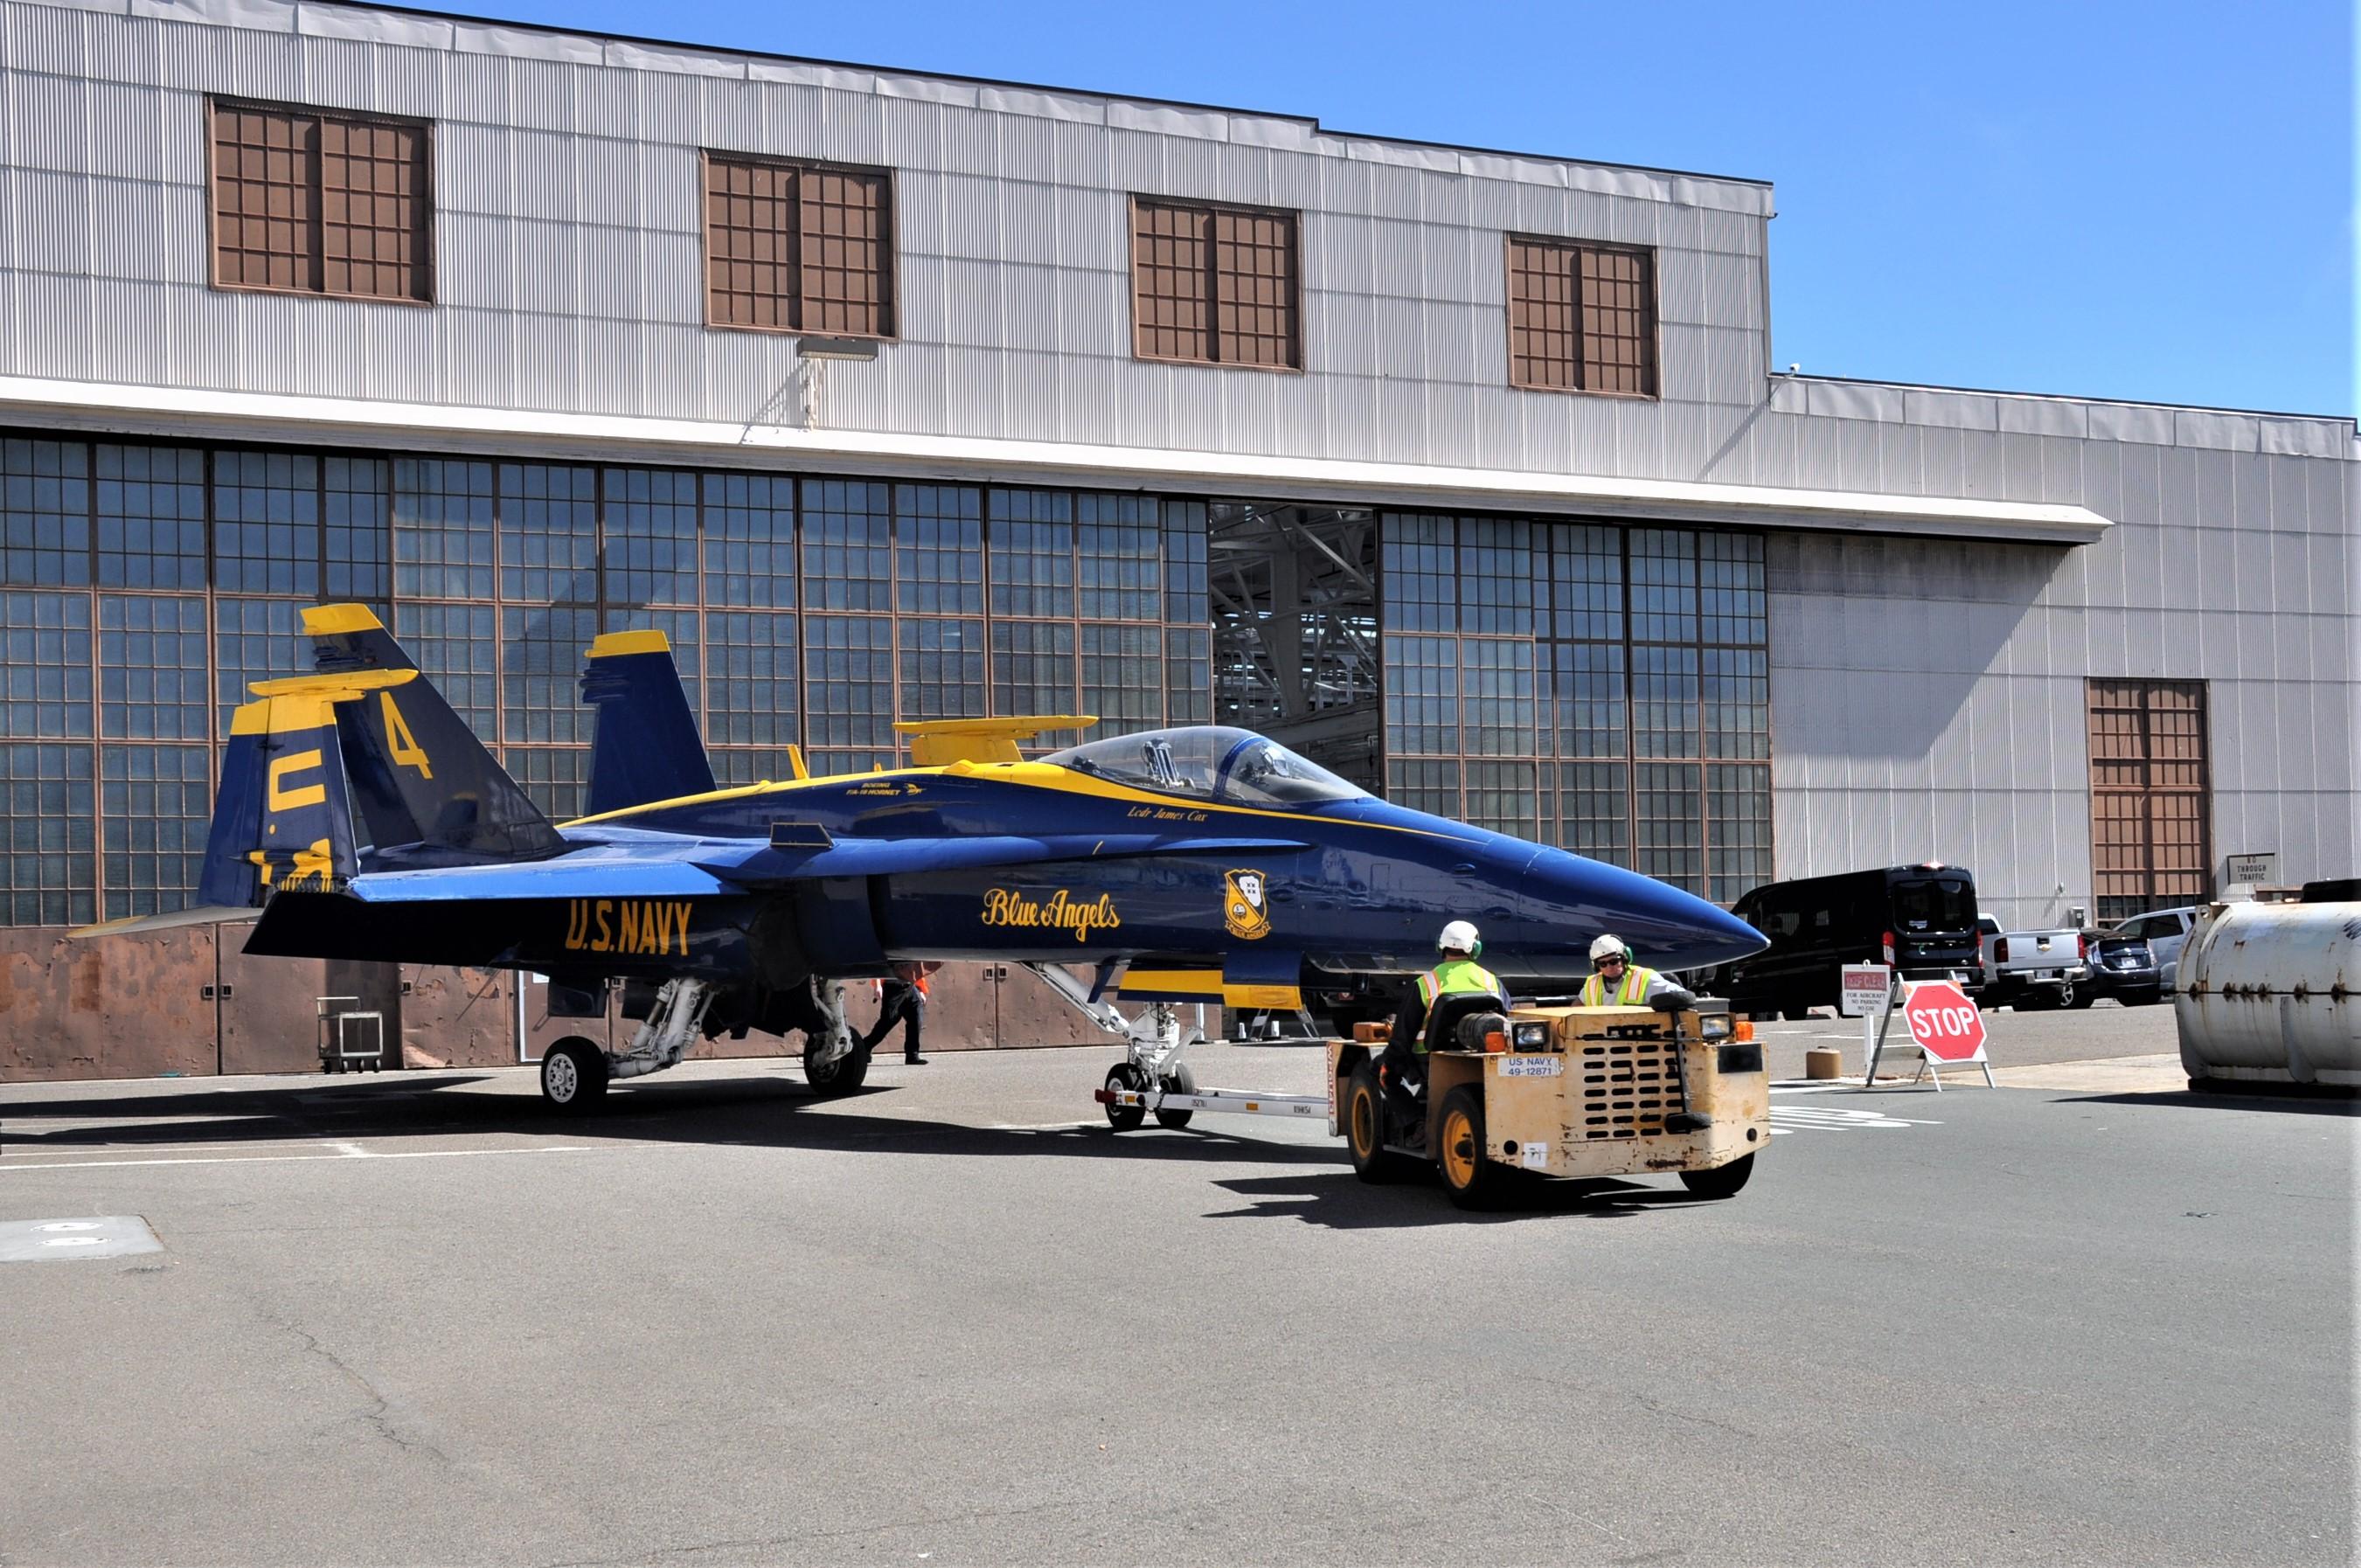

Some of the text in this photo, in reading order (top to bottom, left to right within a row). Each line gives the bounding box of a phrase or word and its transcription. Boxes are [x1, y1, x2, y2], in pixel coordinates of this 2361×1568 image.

[379, 690, 434, 780] 4
[1127, 806, 1208, 822] Lcdr James Cox
[2237, 864, 2267, 873] THROUGH
[981, 888, 1121, 942] Blue Angels
[617, 900, 693, 956] NAVY
[1912, 1006, 1975, 1038] STOP
[1508, 1066, 1552, 1076] 49-12871
[1509, 1058, 1552, 1066] US NAVY
